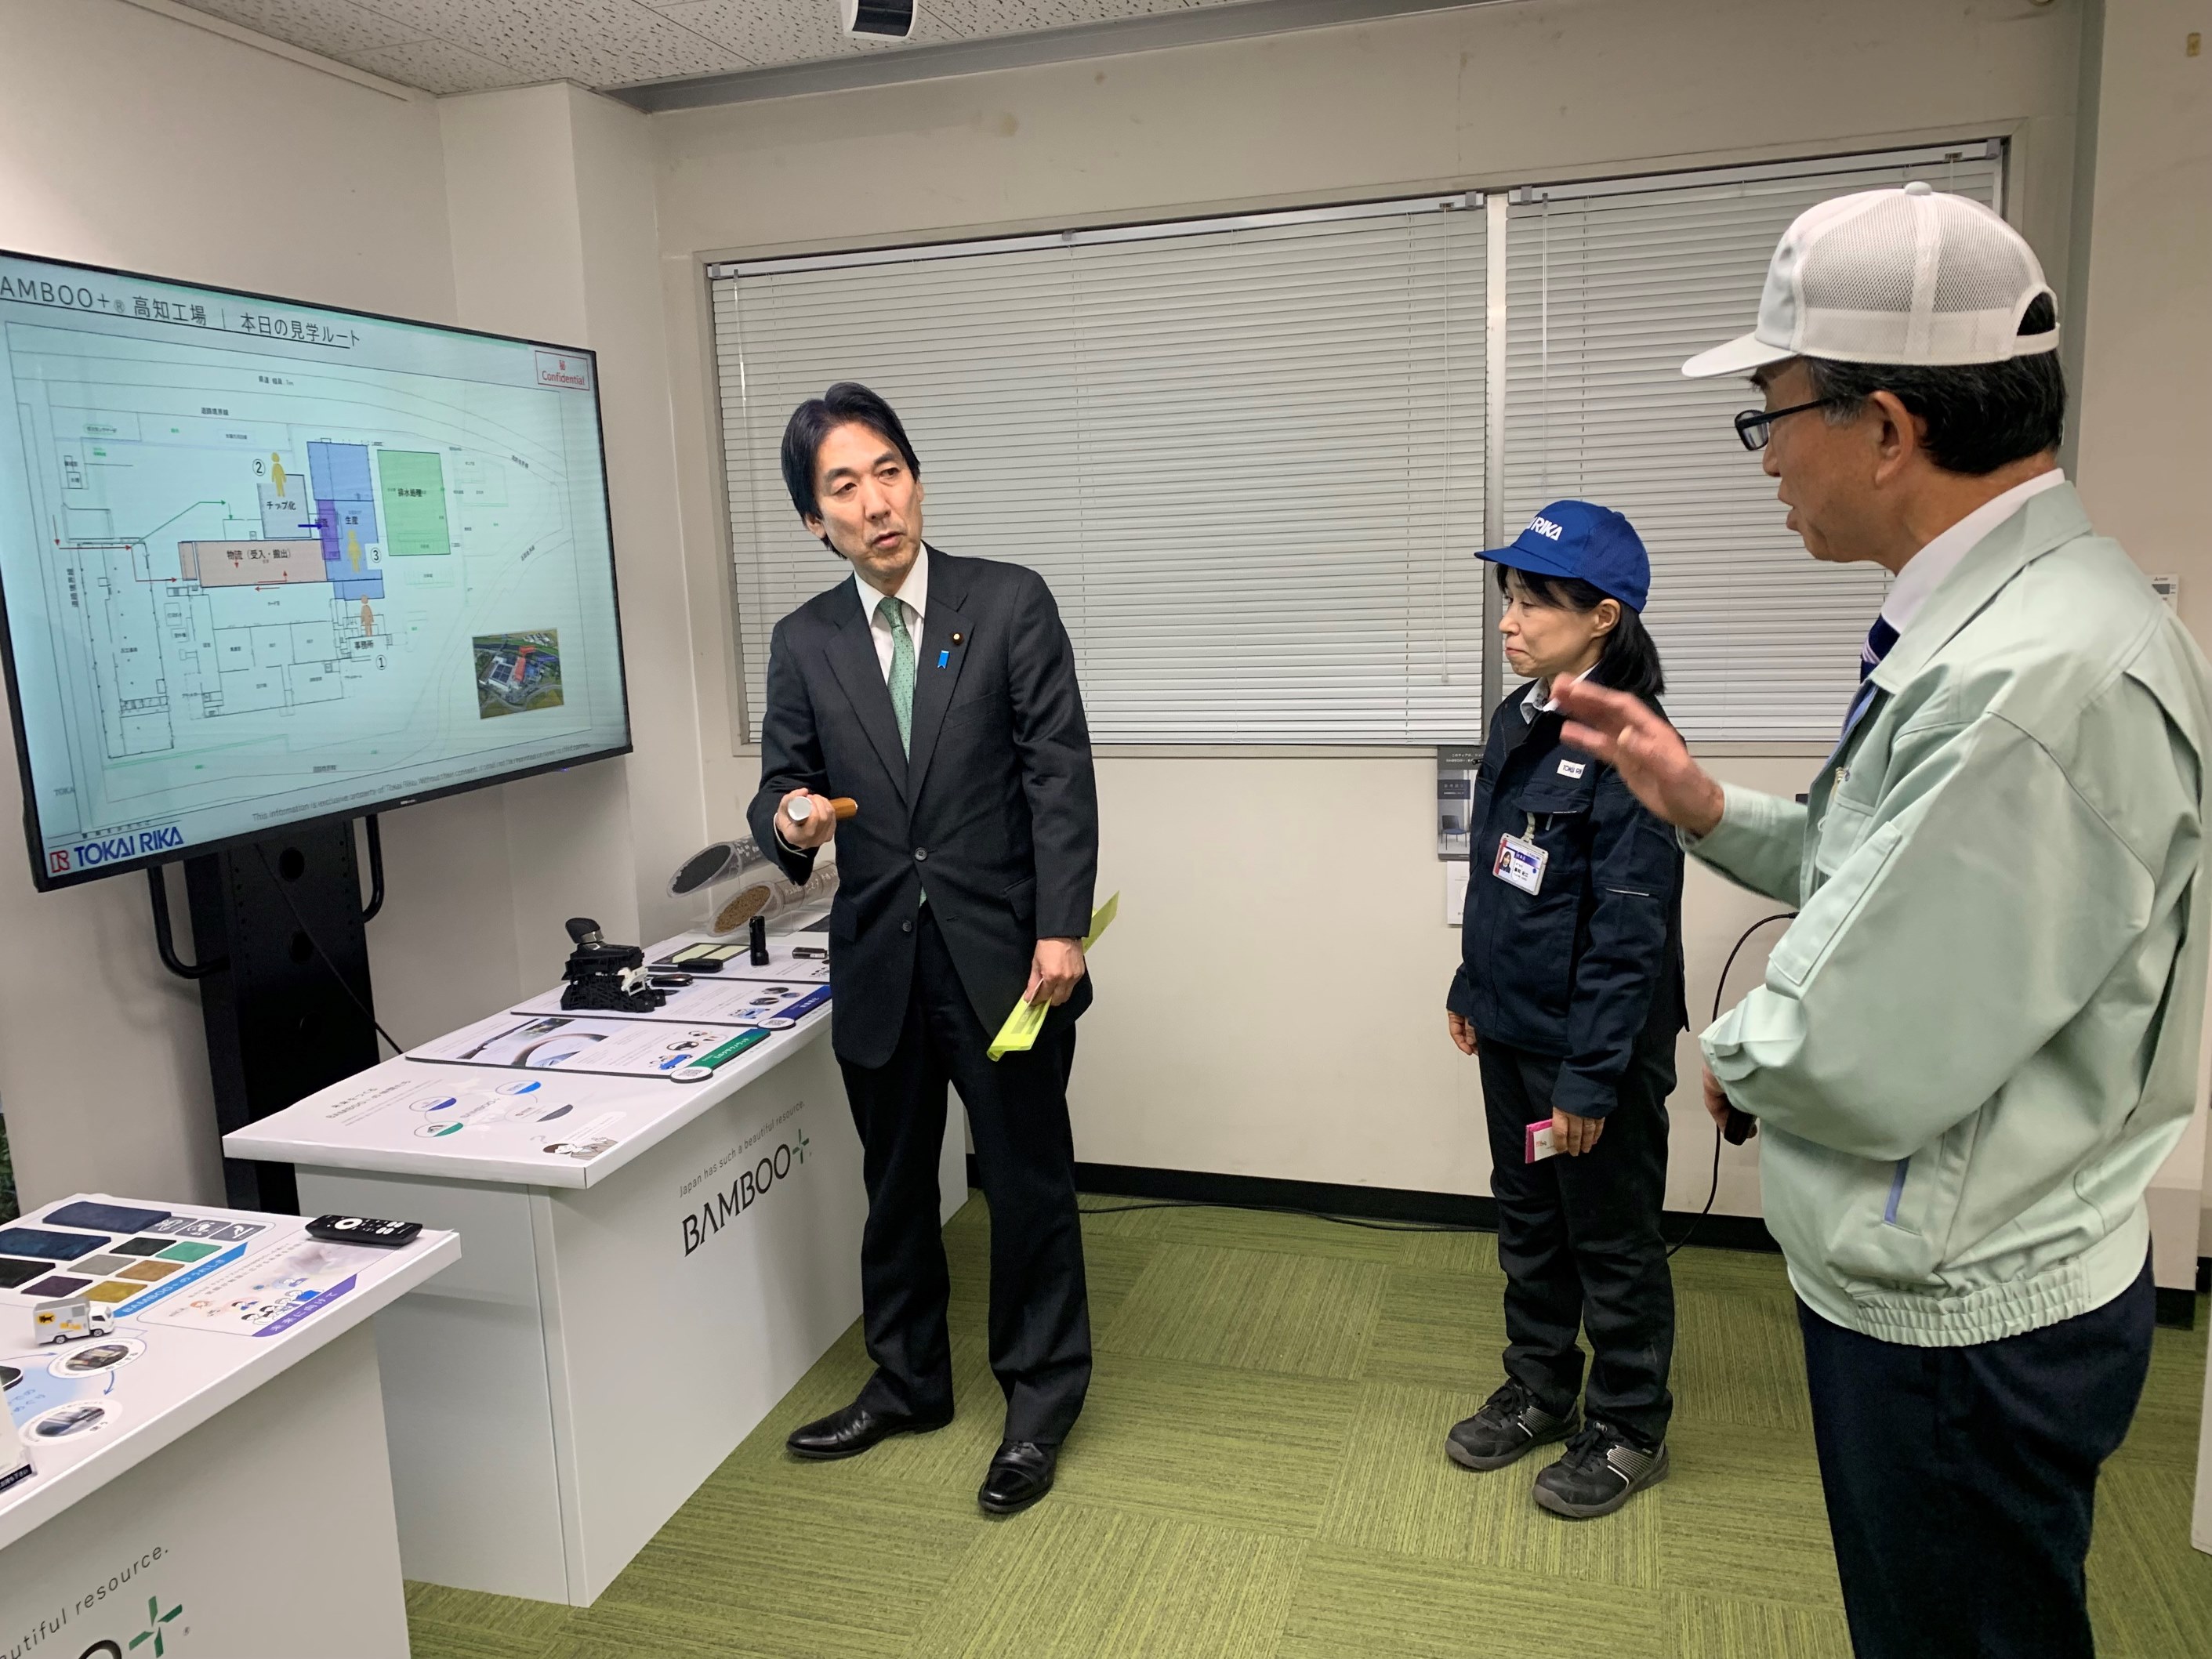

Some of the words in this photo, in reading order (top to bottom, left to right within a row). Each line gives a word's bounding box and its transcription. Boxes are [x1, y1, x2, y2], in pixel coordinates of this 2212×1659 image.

[132, 295, 206, 325] 高知工場
[241, 313, 360, 346] 本日の見学ルート
[542, 370, 586, 386] Confidential
[397, 488, 423, 498] 排水処理
[266, 500, 296, 511] チップ化
[345, 516, 359, 525] 生産
[1530, 516, 1563, 542] RIKA
[354, 639, 375, 650] 事務所
[252, 812, 268, 822] This
[269, 804, 310, 818] information
[74, 835, 136, 867] TOKAI
[139, 826, 184, 853] RIKA
[679, 1175, 702, 1197] Japan
[703, 1166, 718, 1179] has
[719, 1149, 737, 1168] such
[744, 1119, 774, 1149] beautiful
[776, 1100, 806, 1126] resource.
[270, 1291, 338, 1331] 未来に向けて
[75, 1546, 169, 1616] resource.
